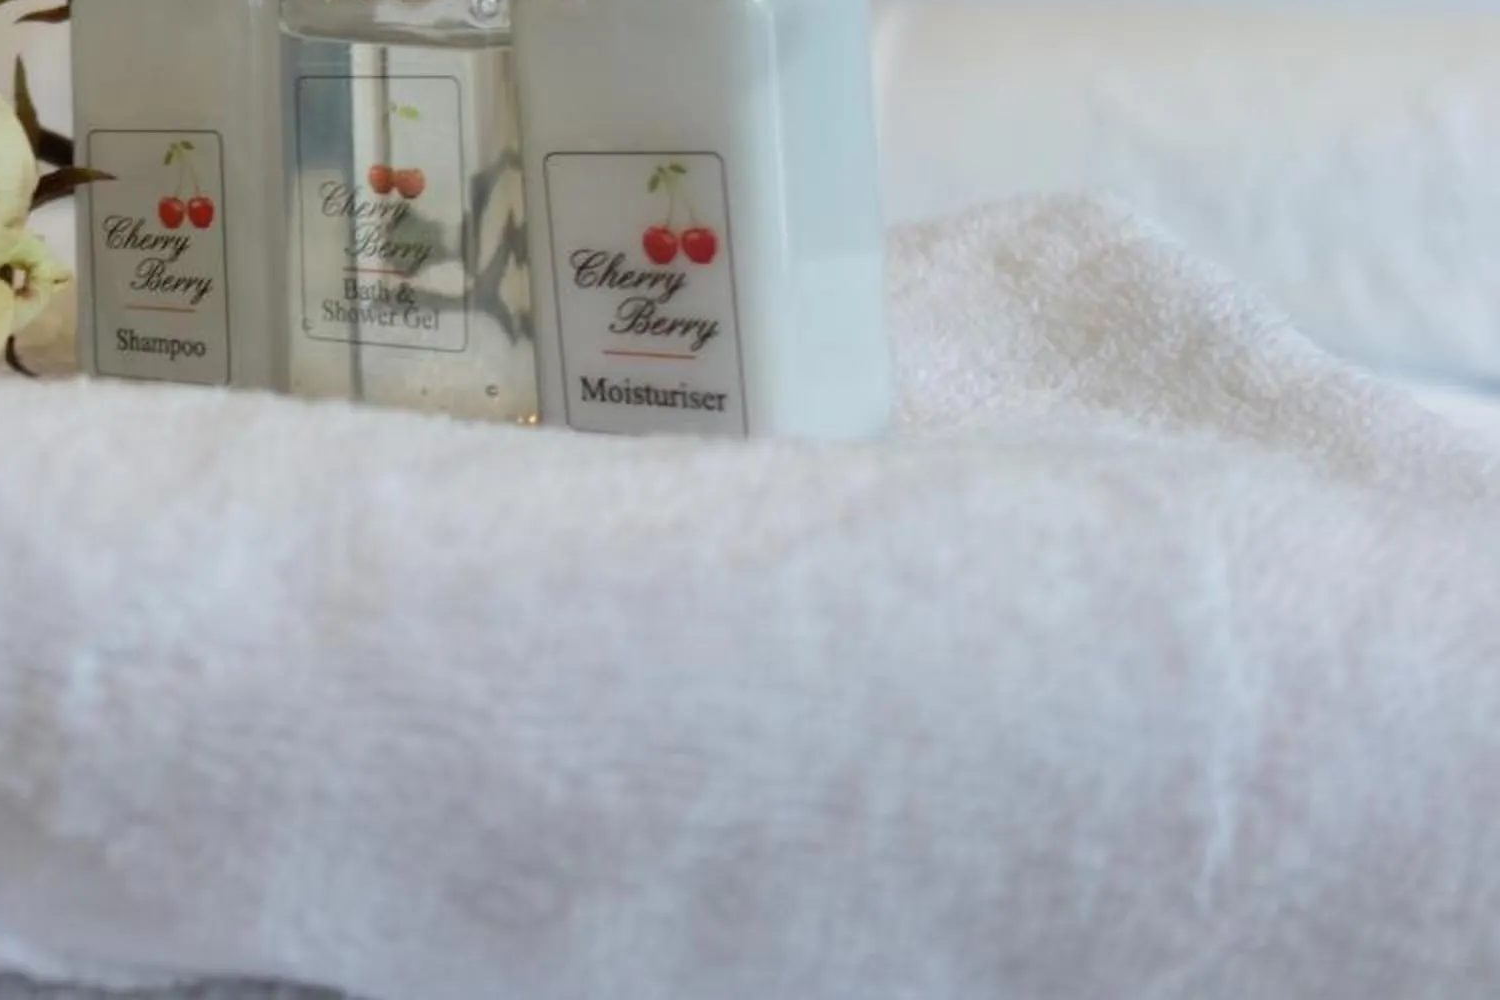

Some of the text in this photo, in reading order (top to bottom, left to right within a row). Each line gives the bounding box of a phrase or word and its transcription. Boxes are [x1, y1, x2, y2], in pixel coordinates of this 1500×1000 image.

[319, 180, 411, 232] Cherry
[102, 214, 192, 262] Cherry
[344, 221, 433, 276] Berry
[129, 257, 213, 305] Berry
[343, 277, 416, 305] Bath &
[569, 249, 688, 304] Cherry
[321, 299, 440, 331] Shower Gel
[608, 297, 719, 352] Berry
[116, 327, 207, 362] Shampoo
[579, 375, 728, 412] Moisturiser
